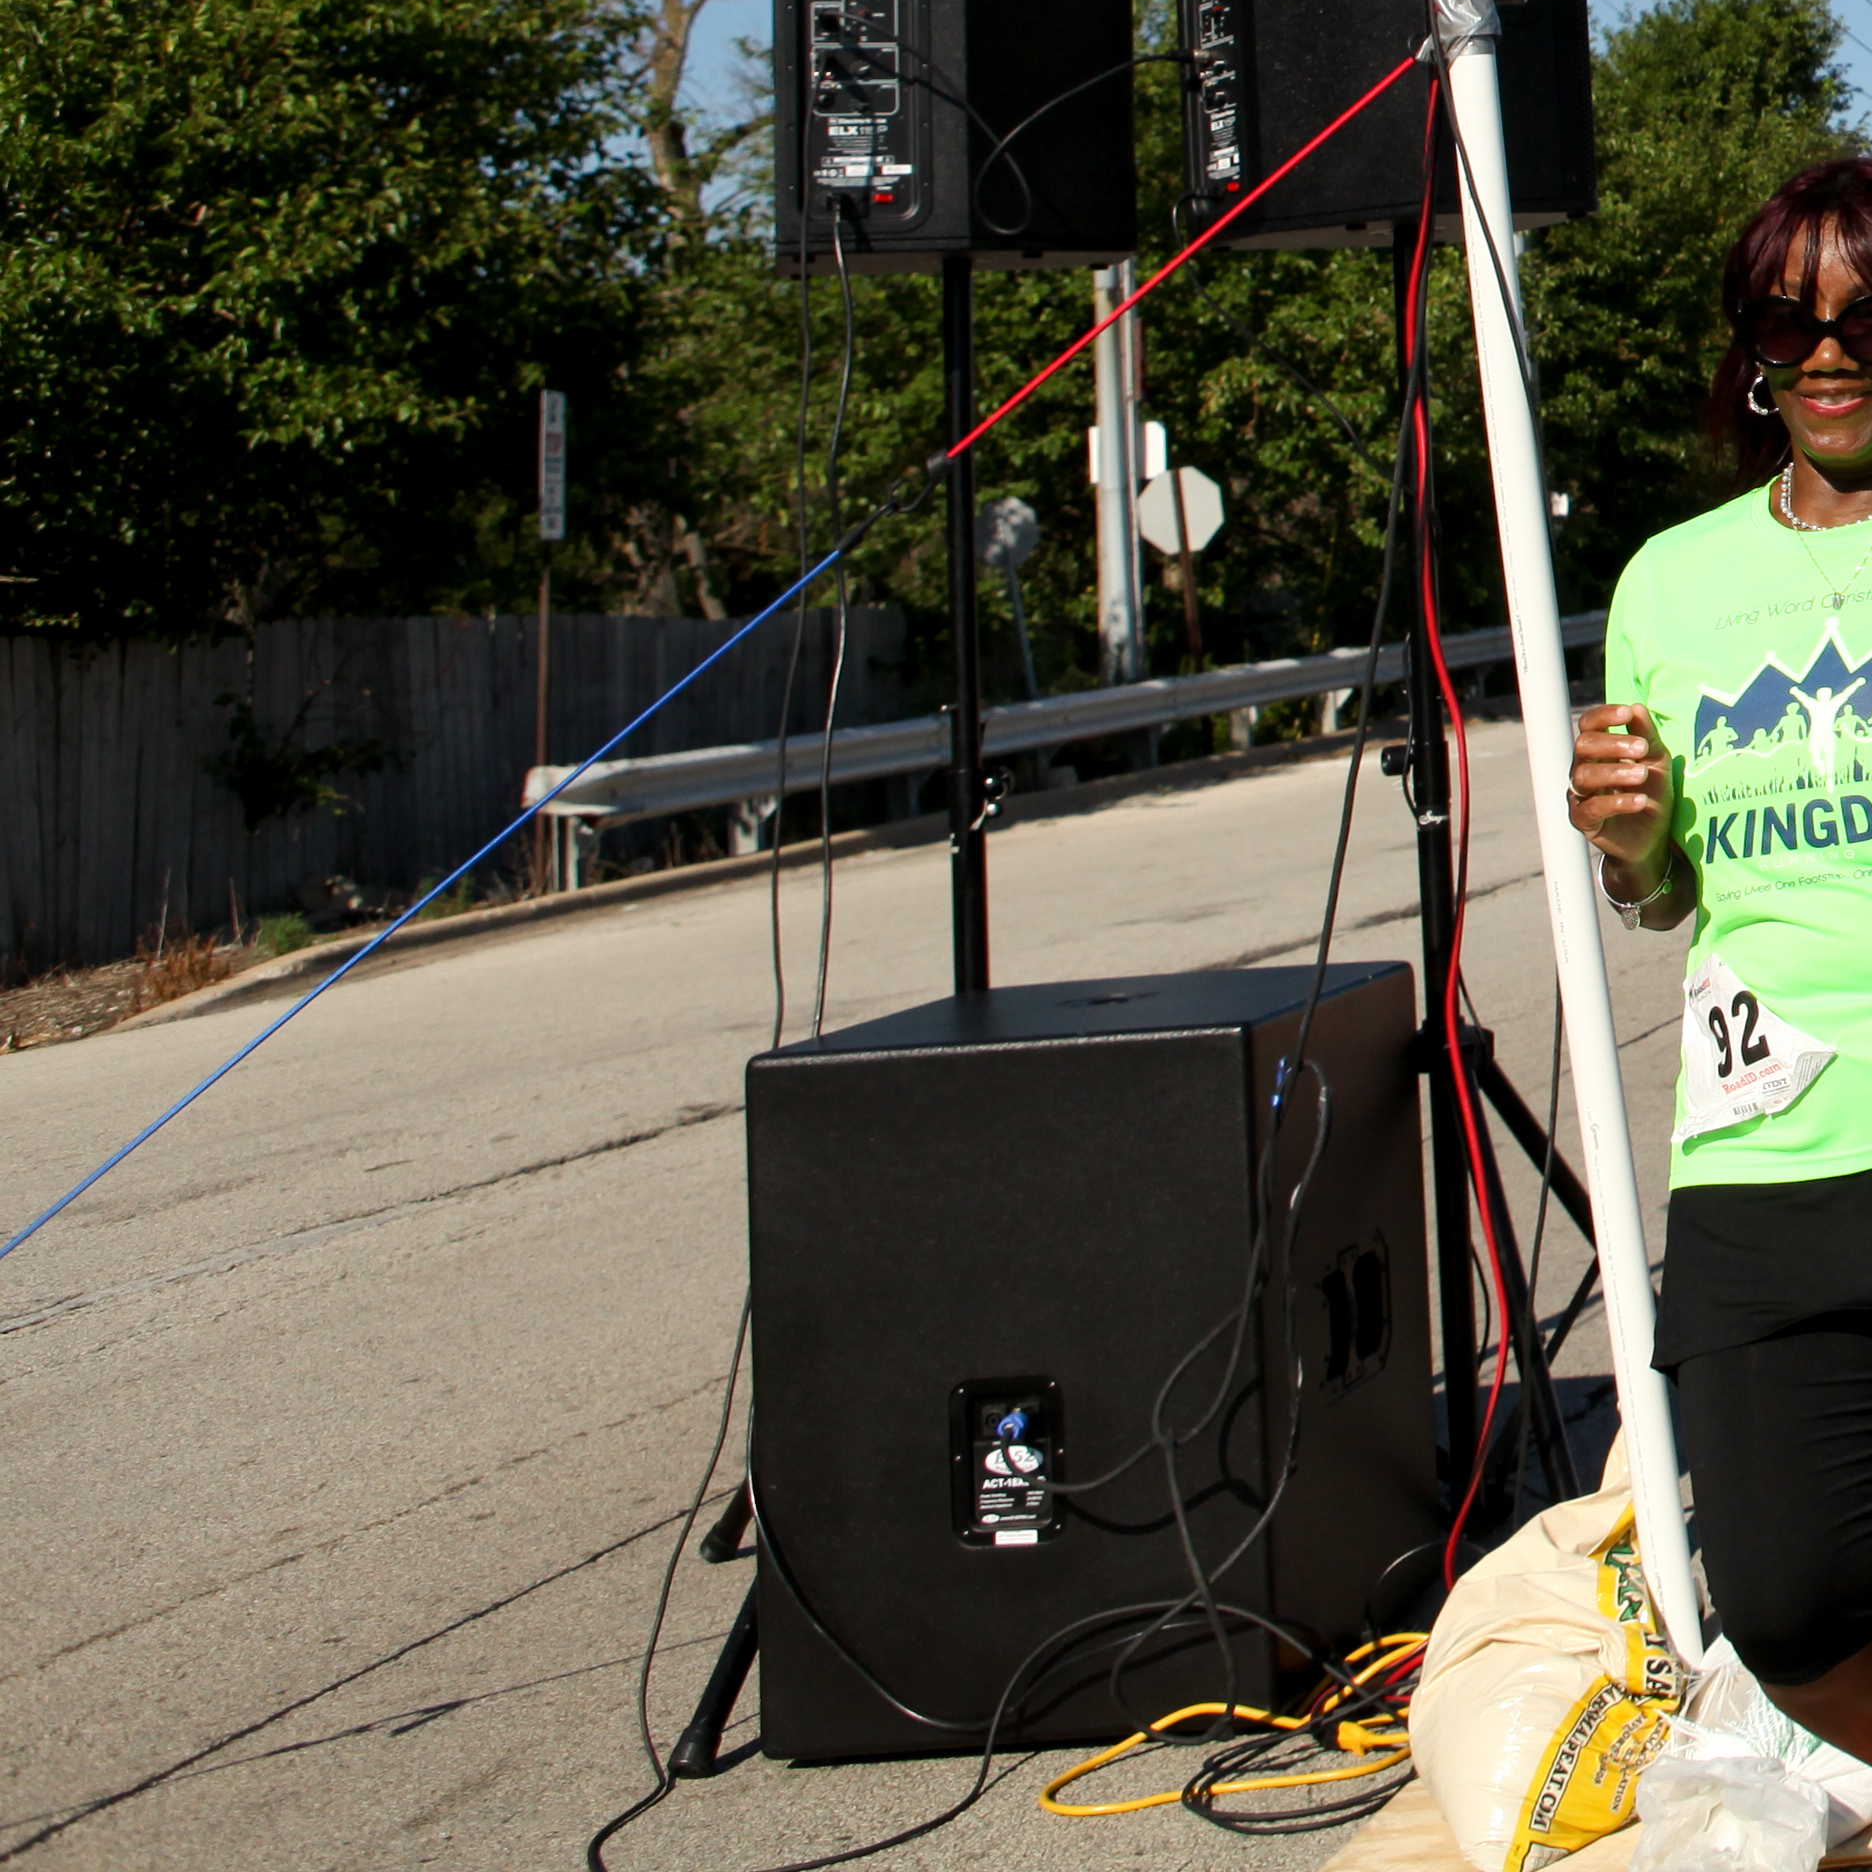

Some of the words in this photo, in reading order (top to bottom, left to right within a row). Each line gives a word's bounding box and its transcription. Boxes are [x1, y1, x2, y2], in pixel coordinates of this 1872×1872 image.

[1714, 608, 1761, 631] Living
[1767, 597, 1814, 618] Word
[1759, 849, 1856, 871] RUNNING
[1775, 880, 1796, 890] One
[1708, 990, 1771, 1078] 92
[1722, 1063, 1781, 1095] RoadID.com
